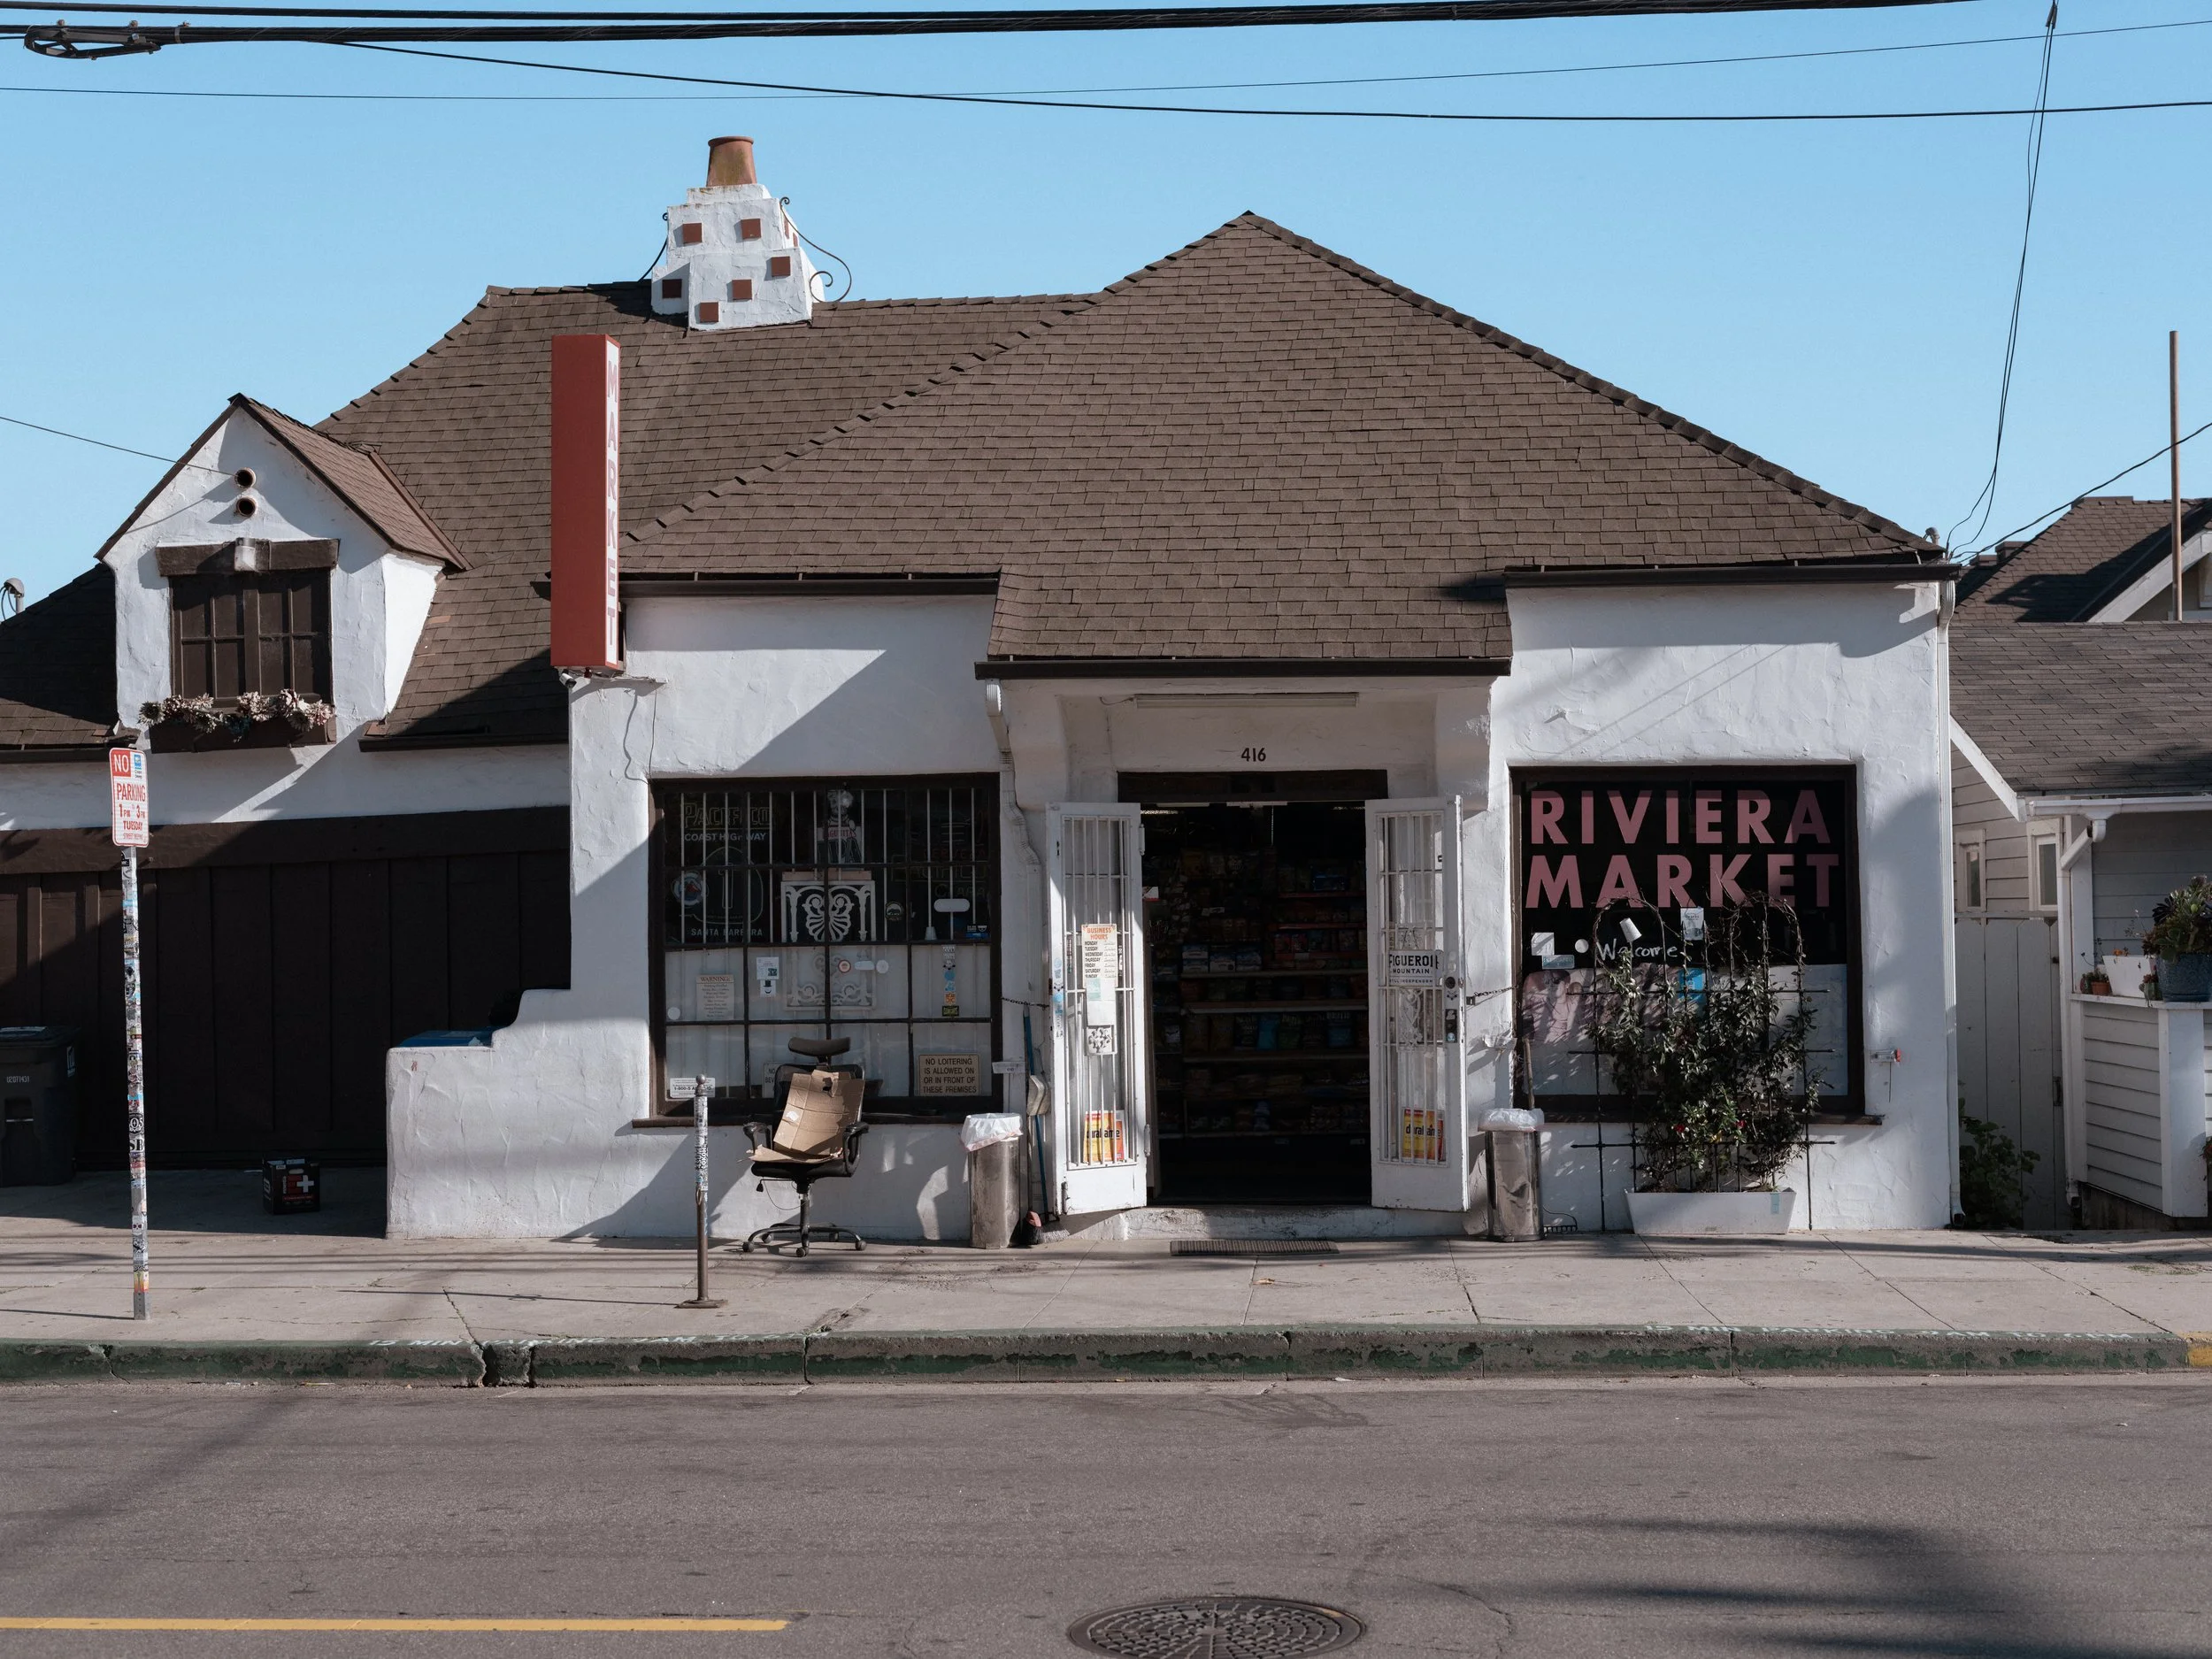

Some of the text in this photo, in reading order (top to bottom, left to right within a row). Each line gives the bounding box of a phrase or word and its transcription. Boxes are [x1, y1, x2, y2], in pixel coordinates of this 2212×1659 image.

[608, 360, 617, 646] MARKET
[113, 754, 129, 772] NO
[1241, 748, 1266, 762] 416
[117, 783, 146, 802] PARKING
[682, 802, 773, 829] PACIFCO
[1531, 789, 1831, 844] RIVIERA
[123, 820, 143, 831] TUESDAY
[720, 833, 768, 842] HGWAY
[825, 830, 857, 839] AGUITAS
[1525, 853, 1839, 909] MARKET
[724, 928, 764, 937] ARBRA
[1595, 939, 1678, 961] Wecome
[1087, 1128, 1120, 1139] draame
[1405, 1125, 1441, 1137] draame
